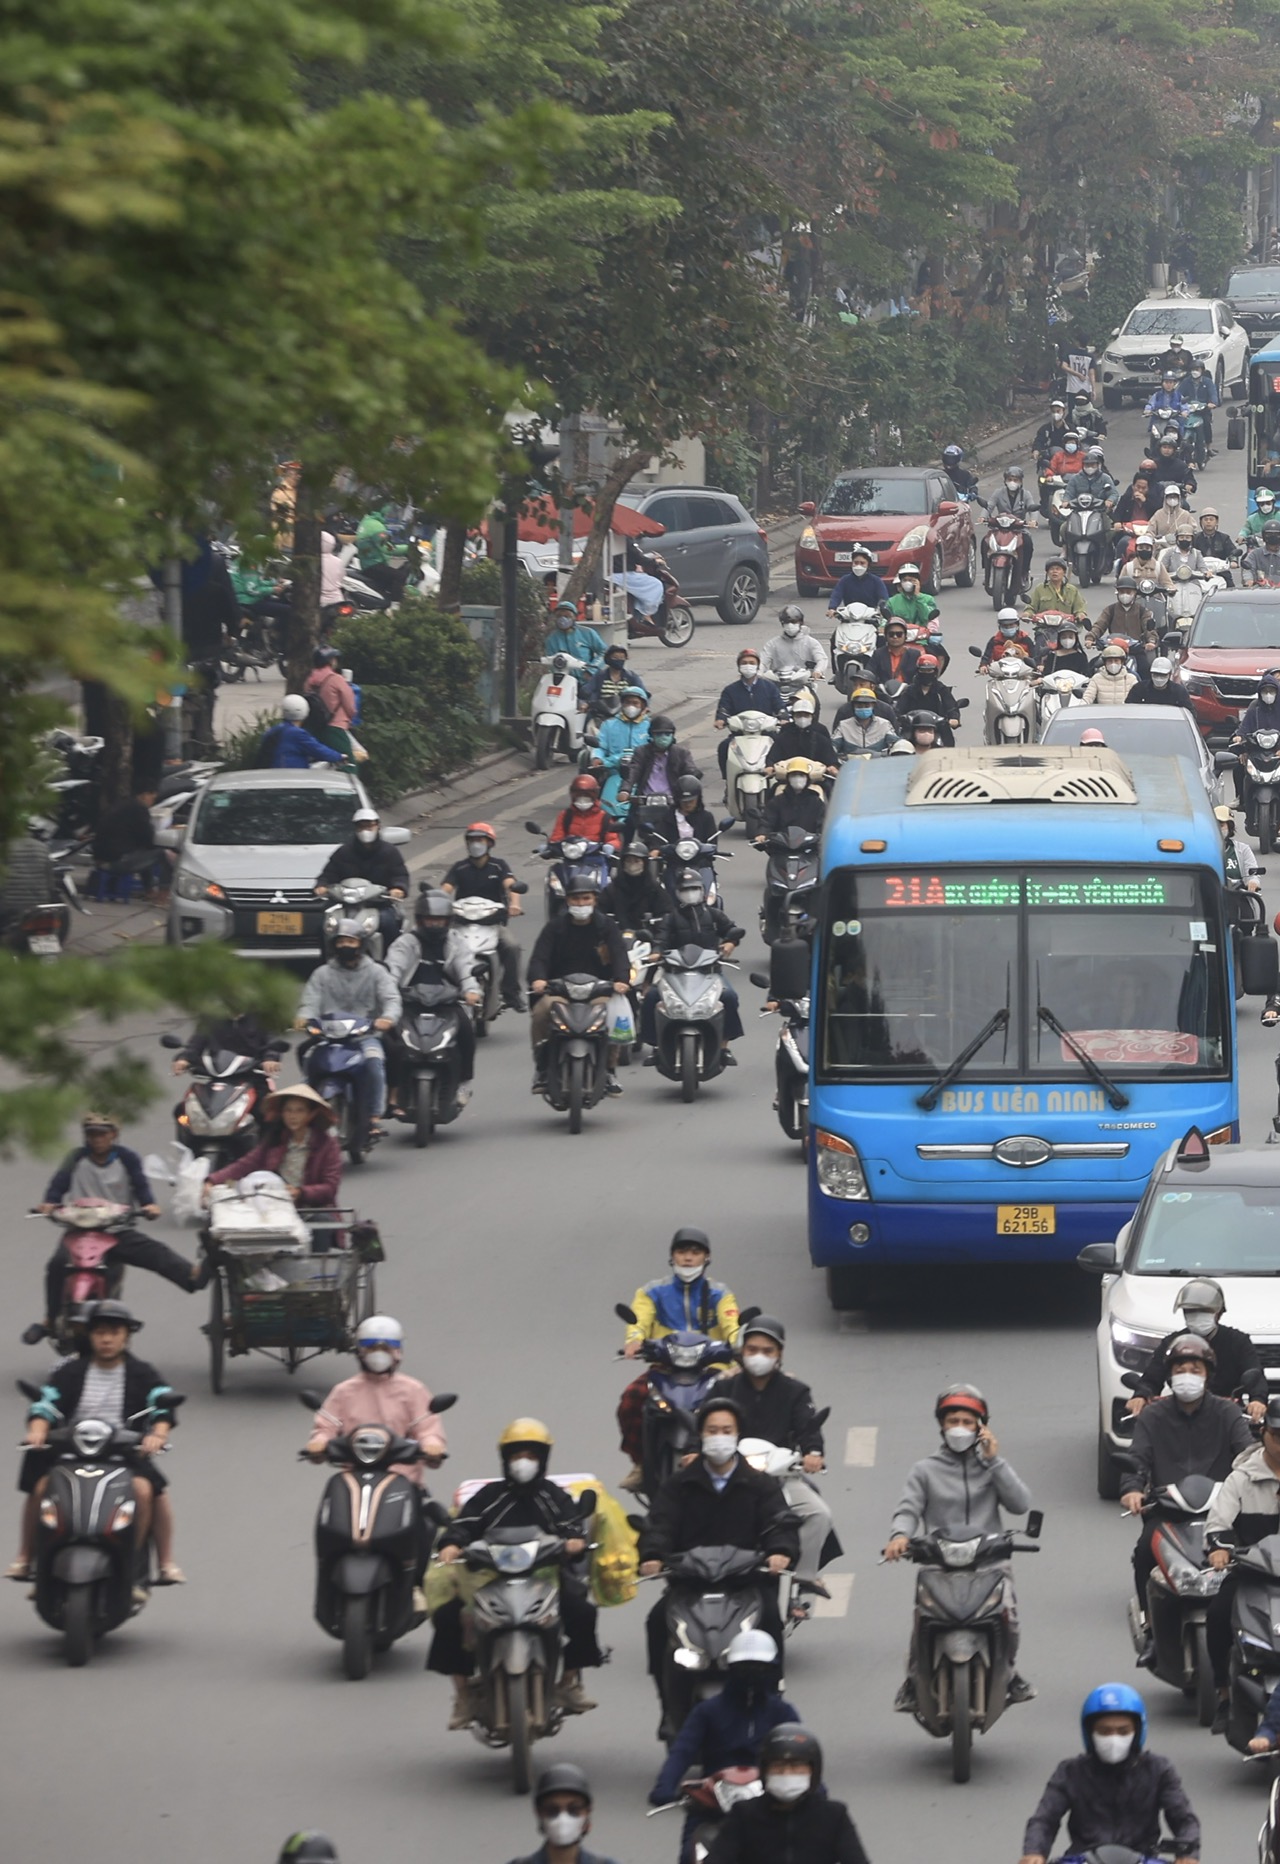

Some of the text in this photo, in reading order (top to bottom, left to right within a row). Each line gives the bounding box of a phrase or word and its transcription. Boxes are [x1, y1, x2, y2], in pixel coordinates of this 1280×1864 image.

[885, 877, 945, 905] 21A
[941, 1091, 985, 1113] BUS
[991, 1085, 1040, 1113] LIÊN
[1013, 1207, 1039, 1219] 29B
[1003, 1219, 1049, 1233] 621.56
